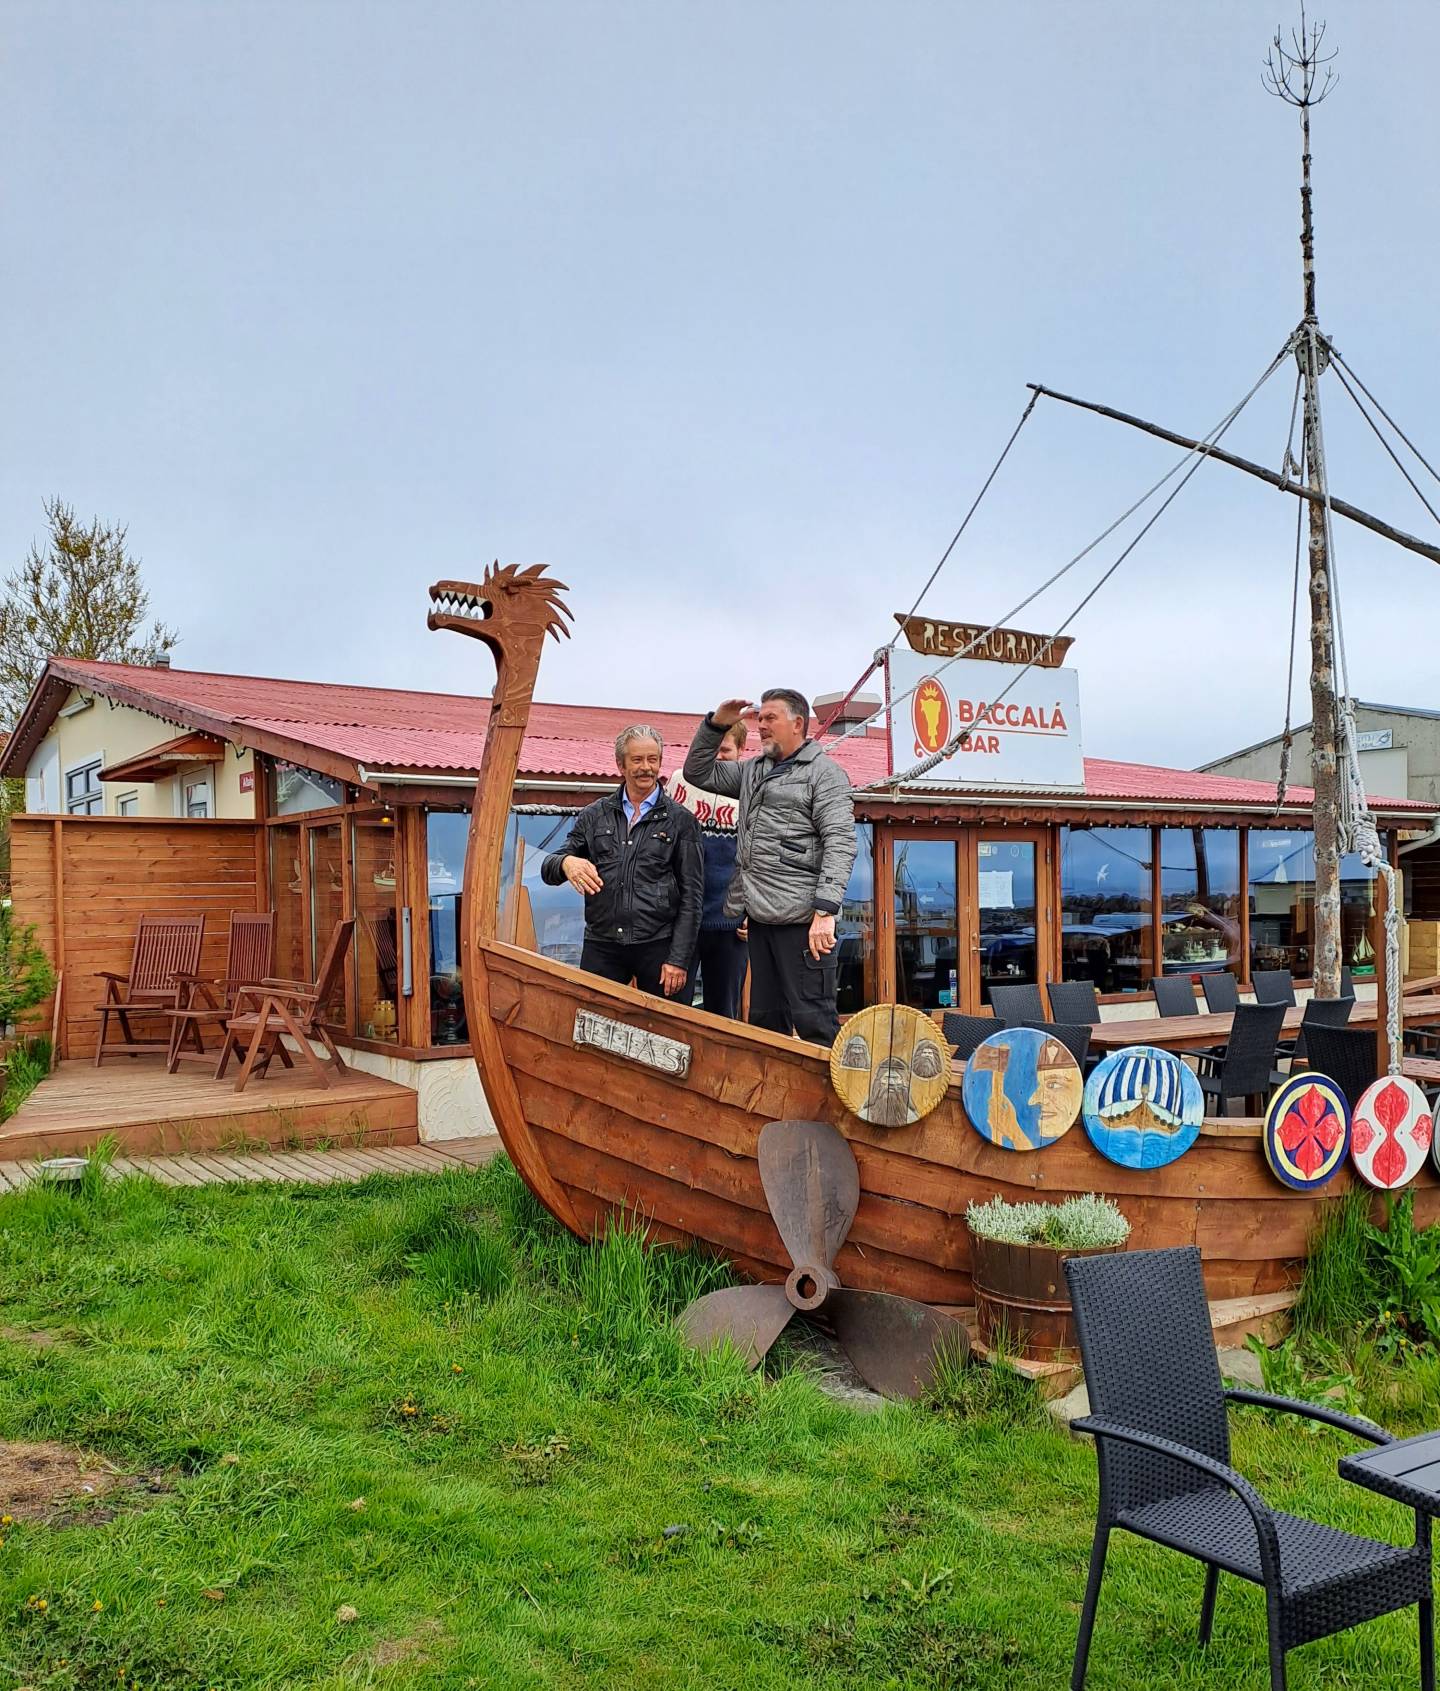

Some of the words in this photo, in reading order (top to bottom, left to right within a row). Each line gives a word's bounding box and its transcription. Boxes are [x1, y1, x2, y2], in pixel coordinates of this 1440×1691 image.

[923, 622, 1055, 663] RESTAURANT
[958, 699, 1067, 730] BACCALÁ
[960, 734, 1000, 754] BAR
